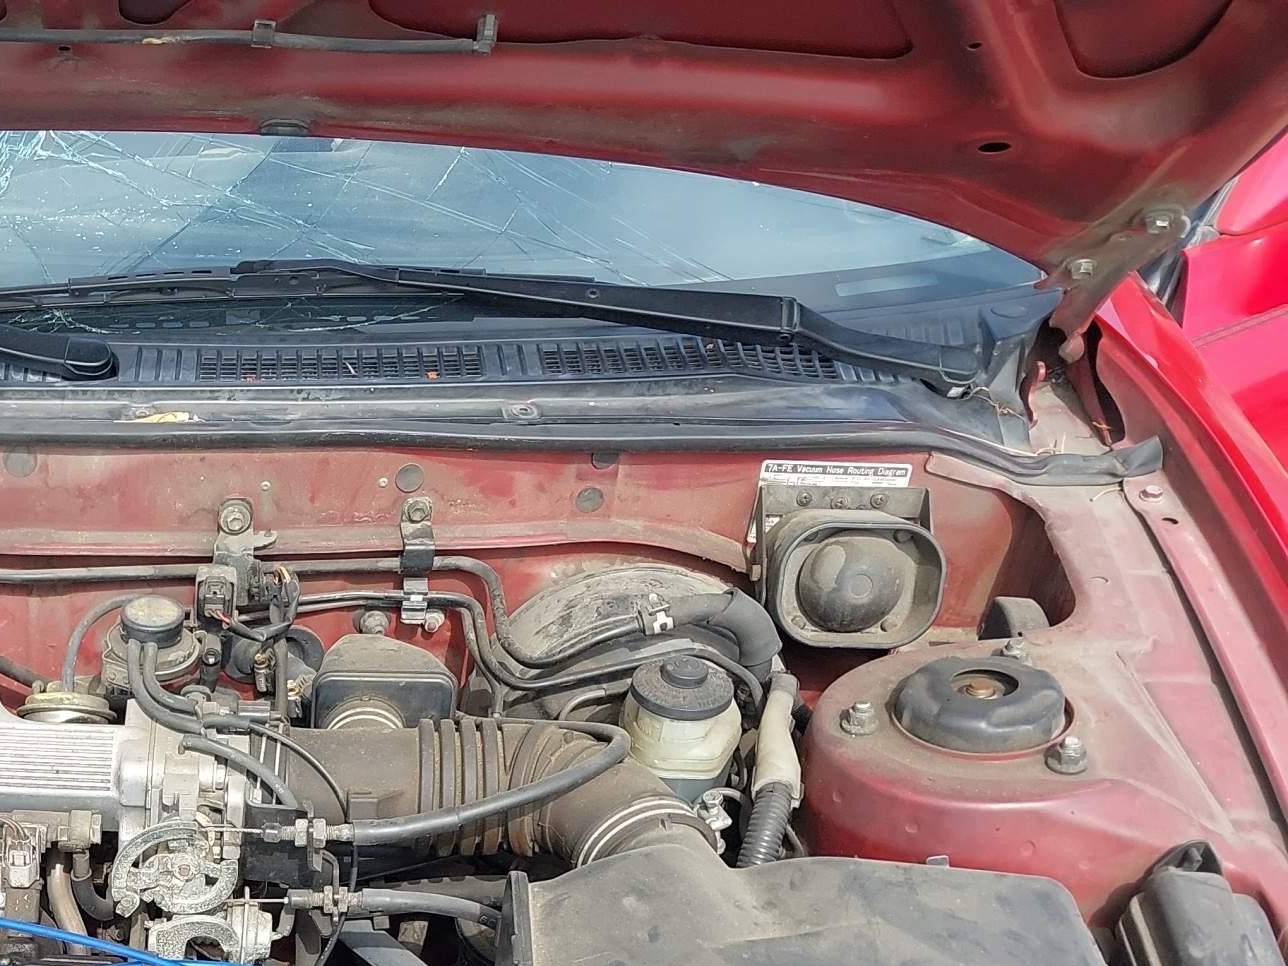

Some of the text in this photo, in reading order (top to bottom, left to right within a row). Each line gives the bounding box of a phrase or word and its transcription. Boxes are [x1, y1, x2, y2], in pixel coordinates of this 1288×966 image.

[767, 463, 906, 477] 7A-FE Vacuum Hose Routing Diagram
